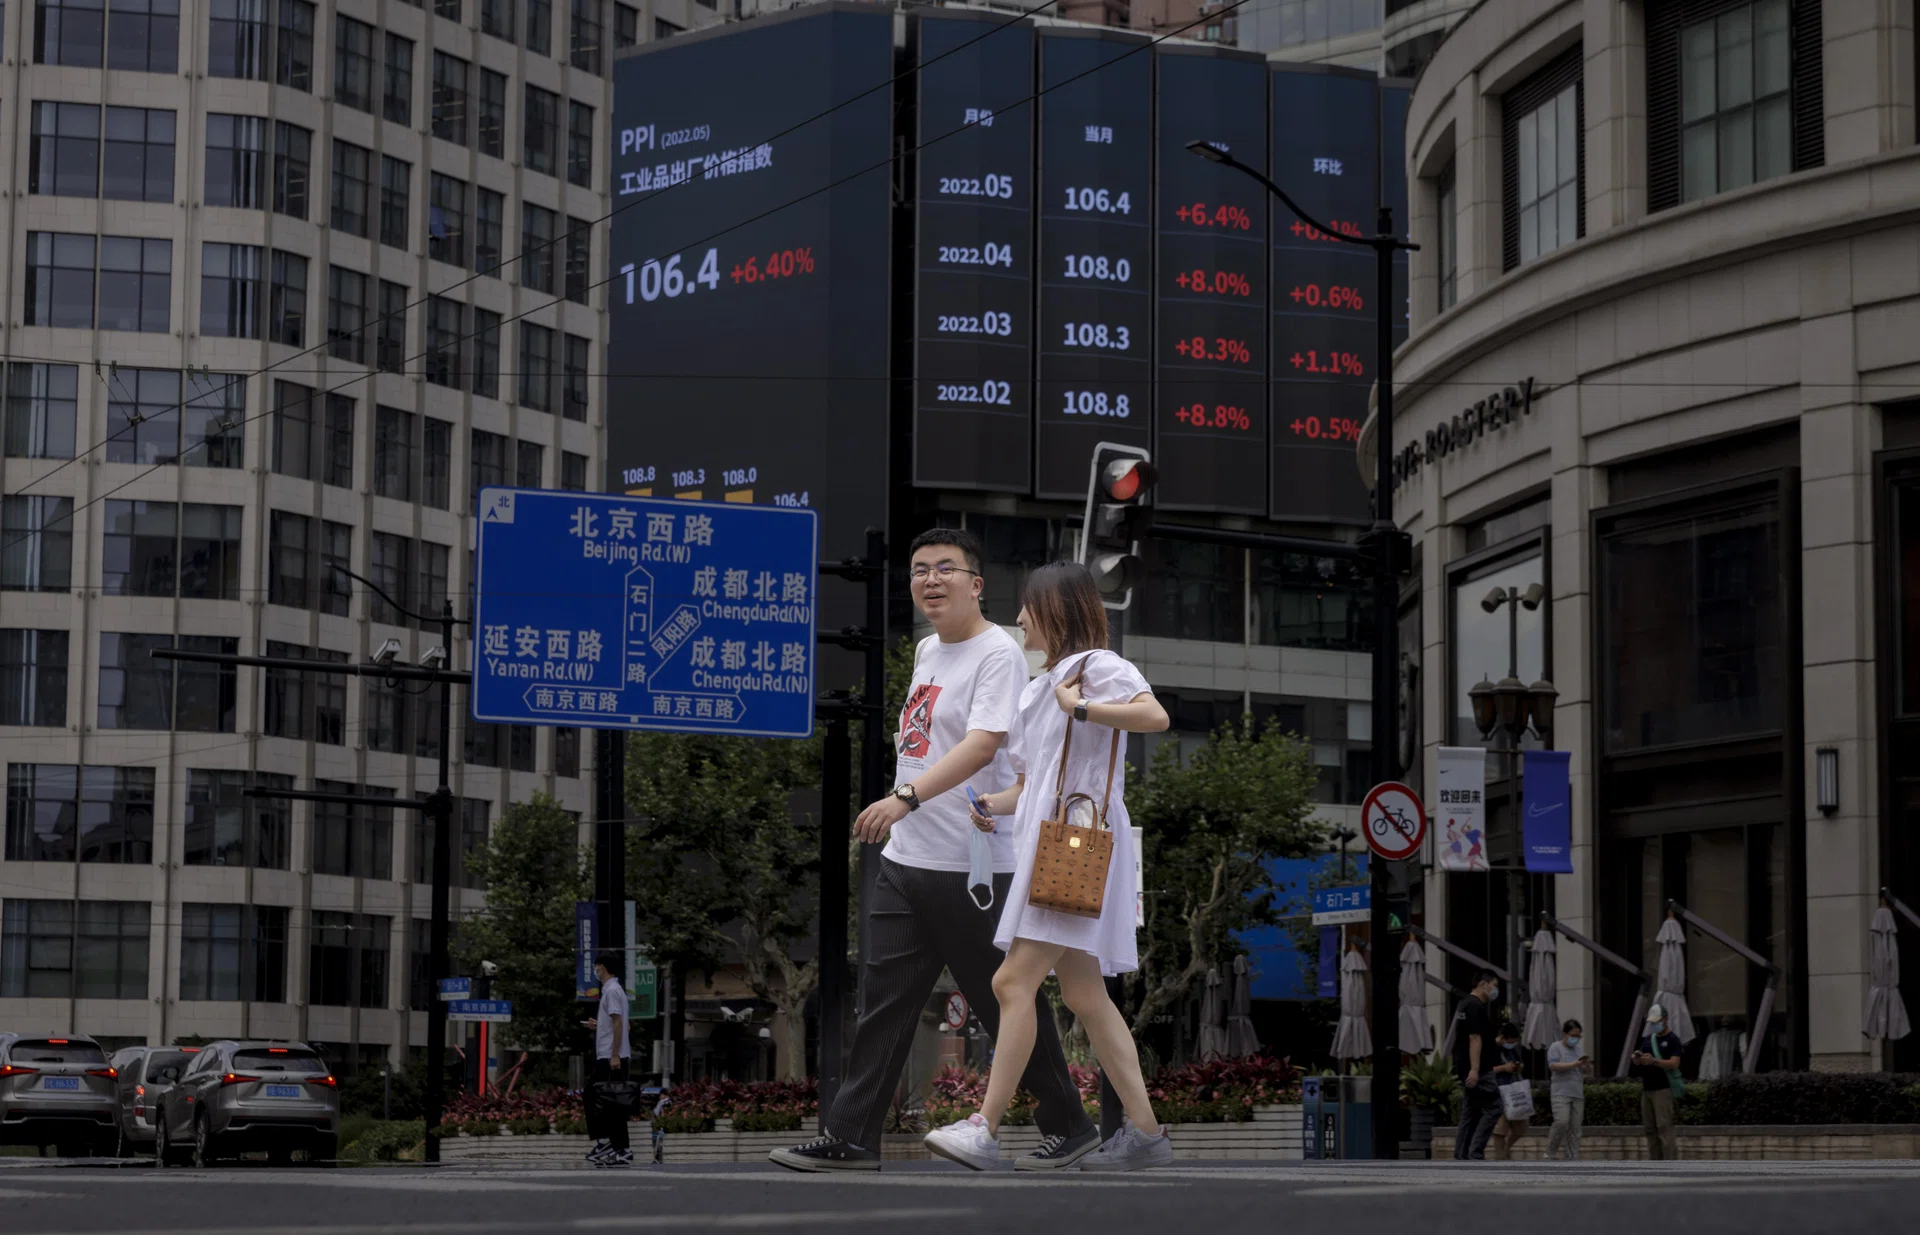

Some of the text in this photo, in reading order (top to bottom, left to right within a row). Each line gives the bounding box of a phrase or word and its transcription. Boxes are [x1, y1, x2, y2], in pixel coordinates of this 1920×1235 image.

[963, 108, 994, 127] 月份
[621, 124, 711, 155] PPI (2022.05)
[1084, 125, 1113, 144] 当月
[619, 143, 773, 195] 工业品出厂价格指数
[1313, 157, 1343, 175] 环比
[939, 173, 1013, 199] 2022.05
[1064, 187, 1131, 214] 106.4
[1175, 203, 1250, 231] +6.4%
[1289, 219, 1363, 242] +0.1%
[938, 242, 1013, 268] 2022.04
[1063, 255, 1131, 282] 108.0
[620, 246, 815, 305] 106.4 +6.40%
[1175, 269, 1250, 297] +8.0%
[1289, 283, 1363, 311] +0.6%
[937, 310, 1012, 336] 2022.03
[1063, 323, 1130, 350] 108.3
[1175, 336, 1250, 364] +8.3%
[1289, 350, 1363, 376] +1.1%
[937, 379, 1012, 406] 2022.02
[1063, 391, 1130, 418] 108.8
[1175, 403, 1250, 431] +8.8%
[1289, 415, 1362, 442] +0.5%
[1425, 377, 1535, 464] ROASTERY
[622, 465, 656, 485] 108.8
[672, 468, 706, 487] 108.3
[722, 467, 757, 487] 108.0
[498, 495, 510, 509] 北
[773, 491, 809, 507] 106.4
[568, 506, 715, 547] 北京西路
[583, 540, 638, 566] Beijing
[692, 565, 808, 602] 成都北路
[483, 624, 603, 663] 延安西路
[627, 584, 650, 684] 石门二路
[650, 608, 698, 660] 凤阳路
[689, 635, 807, 673] 成都北路
[692, 669, 760, 694] Chengdu
[535, 688, 619, 714] 南京西路
[652, 695, 735, 719] 南京西路
[1440, 789, 1481, 804] 欢迎回来
